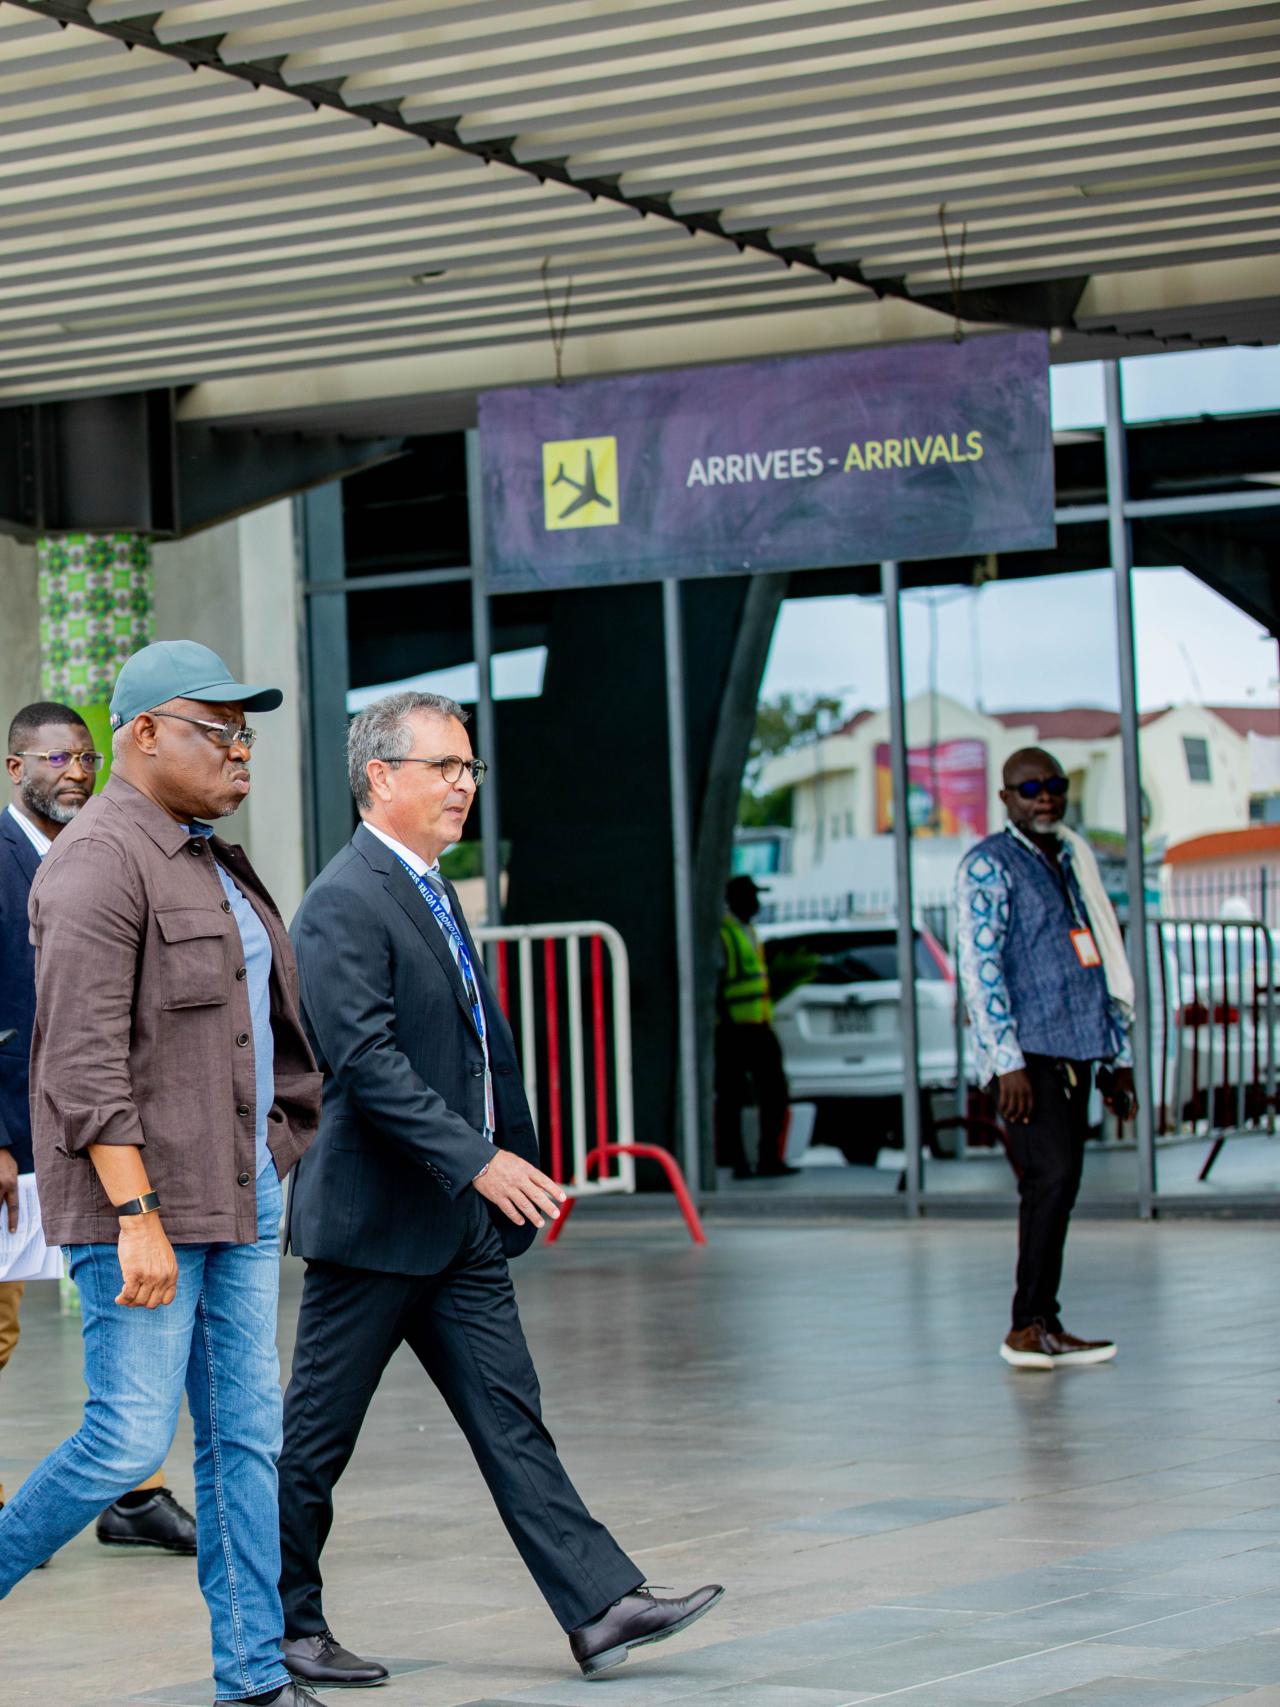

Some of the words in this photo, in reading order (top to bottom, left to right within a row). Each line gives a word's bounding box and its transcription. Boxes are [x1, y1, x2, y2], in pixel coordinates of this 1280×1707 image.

[686, 446, 824, 488] ARRIVEES
[843, 430, 984, 473] ARRIVALS
[418, 882, 437, 908] VOTRE
[437, 911, 464, 946] COTONOU
